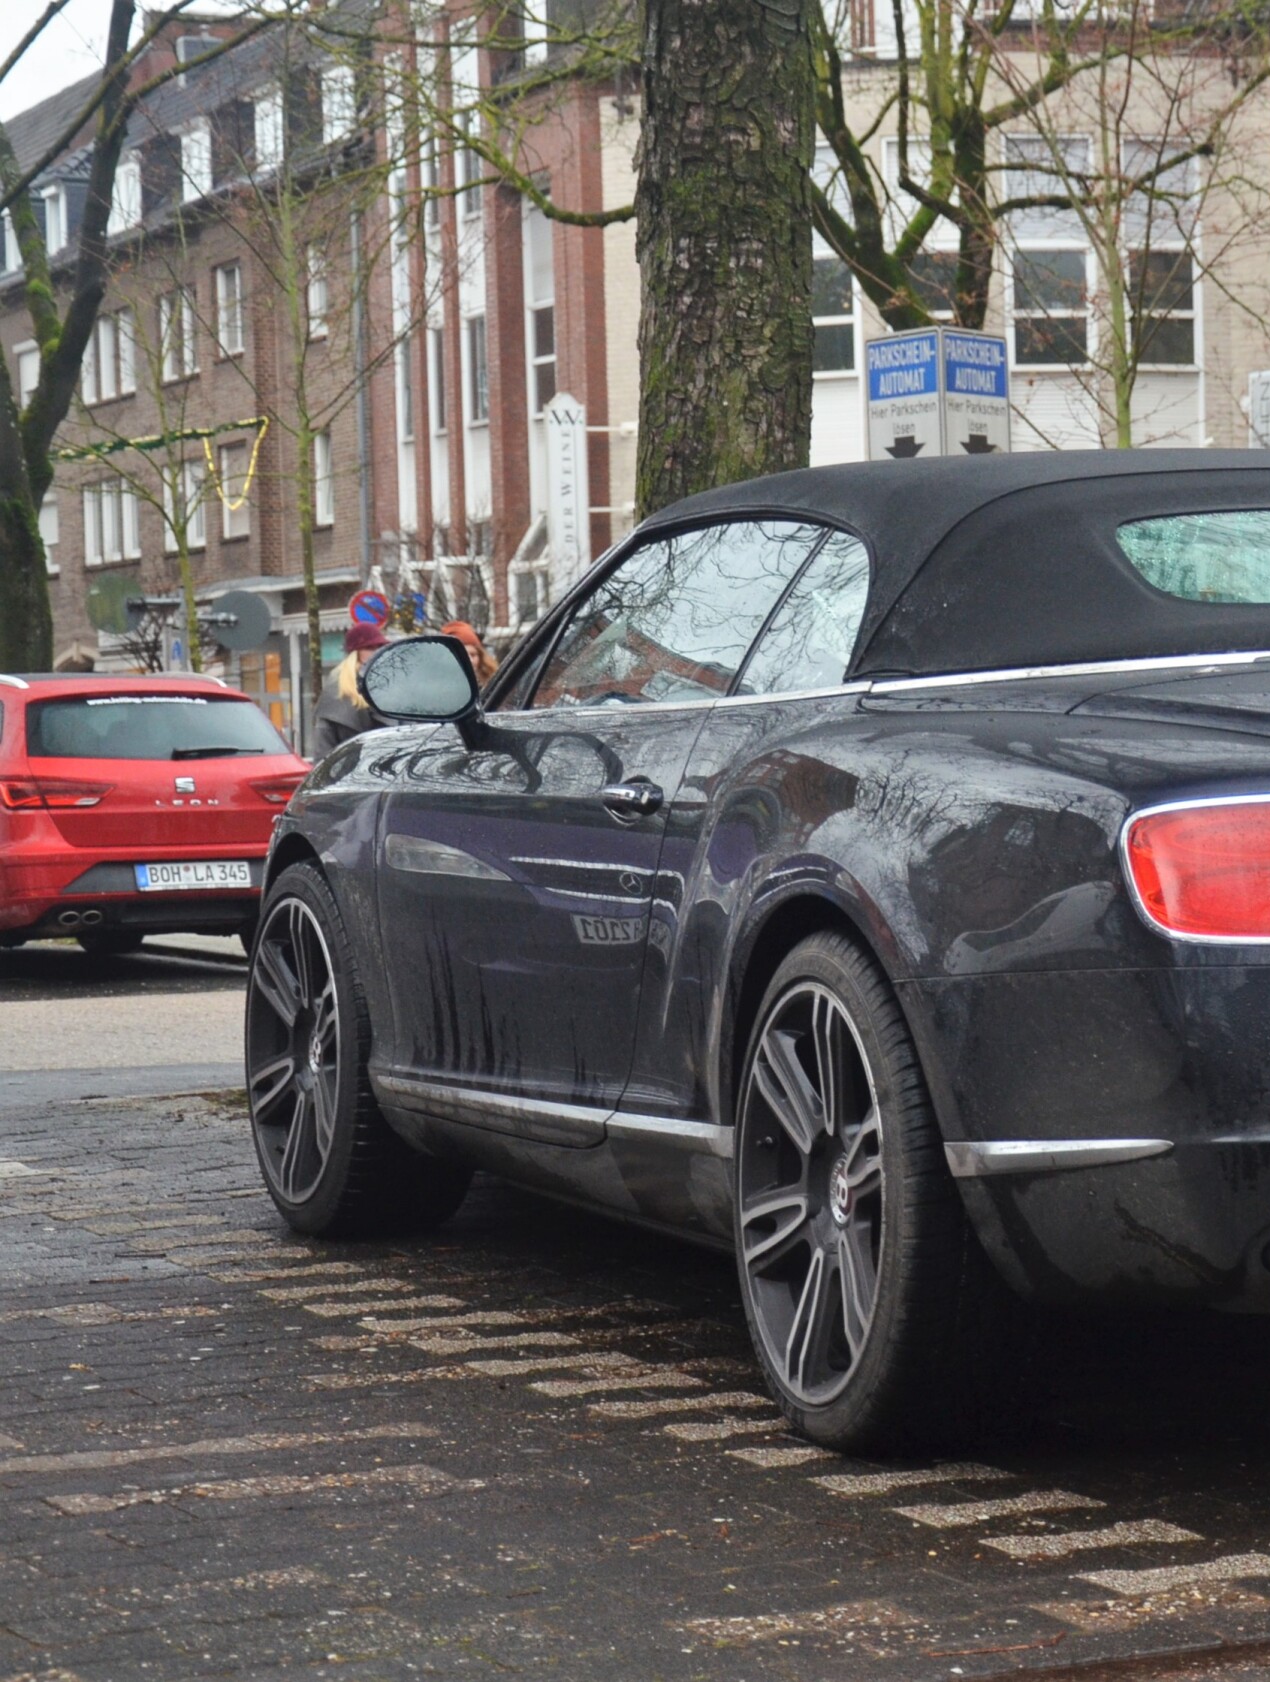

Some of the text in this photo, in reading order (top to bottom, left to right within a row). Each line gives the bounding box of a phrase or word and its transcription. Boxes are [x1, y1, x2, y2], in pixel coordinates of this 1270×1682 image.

[868, 340, 936, 370] PARKSCHEIN-
[945, 338, 1005, 368] PARKSCHEIN-
[879, 368, 926, 396] AUTOMAT
[955, 367, 997, 394] AUTOMAT
[871, 400, 937, 420] Hier Parkschein
[948, 399, 1006, 416] Hier Parkschein
[155, 799, 220, 807] LEON
[149, 864, 248, 884] BOH LA 345
